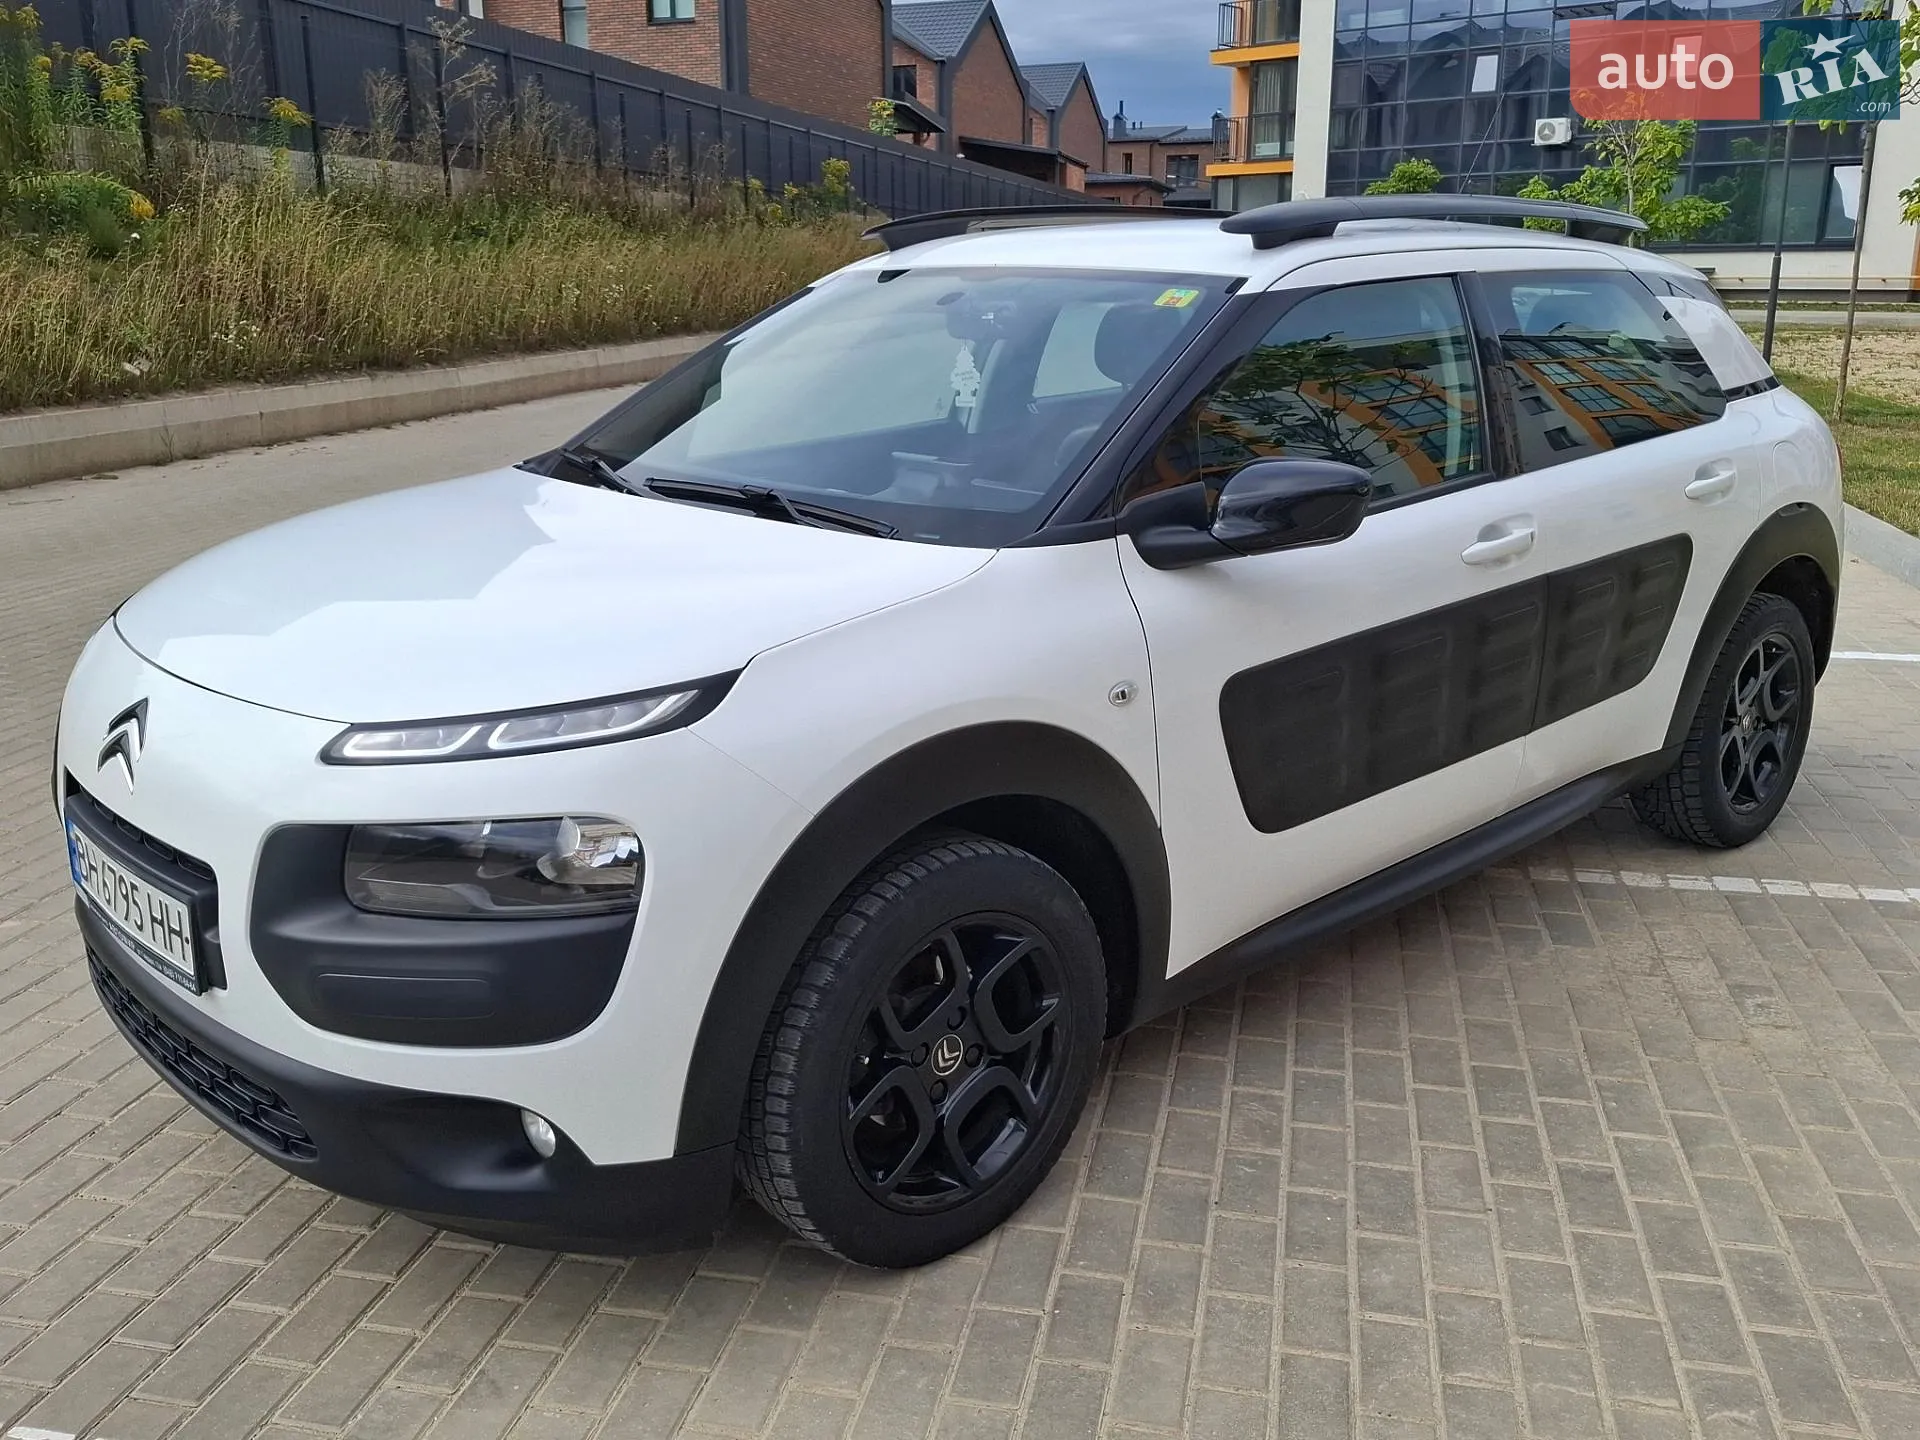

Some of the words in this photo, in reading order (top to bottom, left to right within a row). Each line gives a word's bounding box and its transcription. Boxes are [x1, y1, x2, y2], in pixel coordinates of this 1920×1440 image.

[75, 831, 100, 896] BH
[102, 859, 143, 932] 6795
[147, 891, 186, 963] HH
